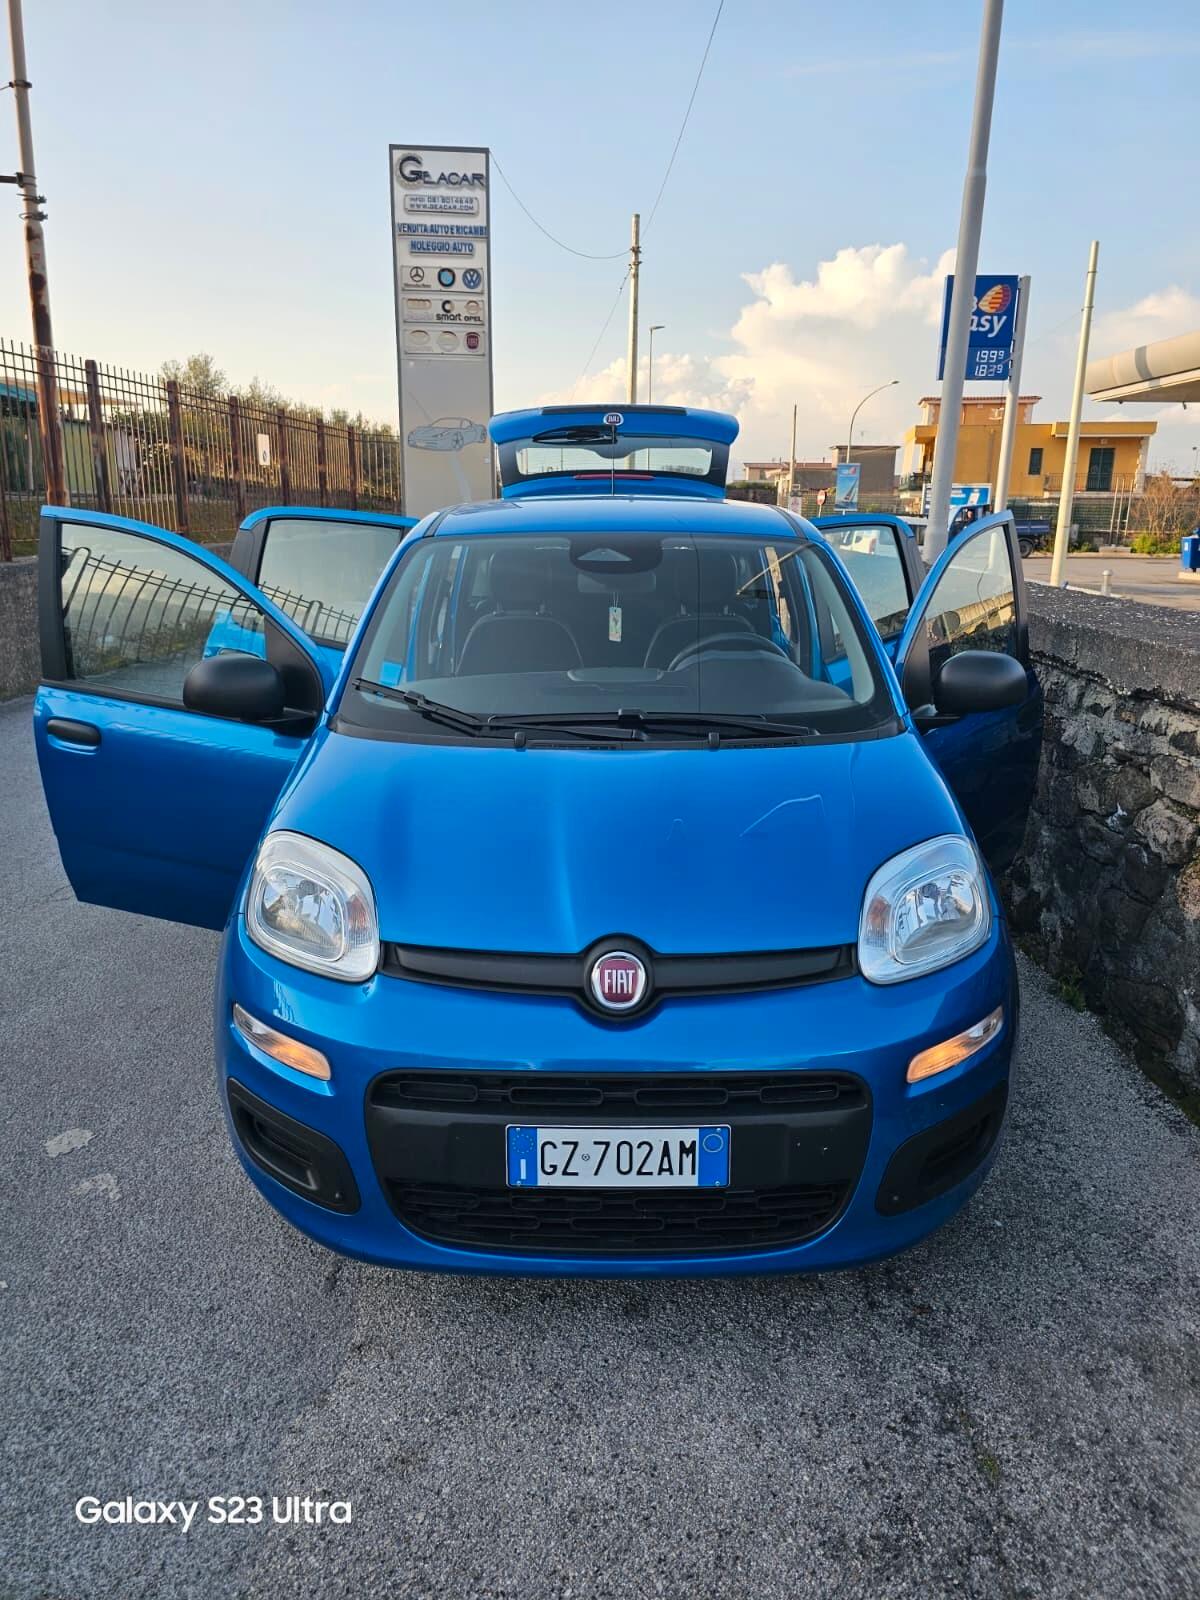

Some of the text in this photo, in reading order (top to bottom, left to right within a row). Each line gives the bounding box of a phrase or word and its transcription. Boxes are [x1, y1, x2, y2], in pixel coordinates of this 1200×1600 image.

[399, 155, 485, 186] GEACAR
[397, 222, 428, 233] VENDITA
[430, 223, 450, 234] AUTO
[410, 239, 474, 253] NOLEGGIO AUTO
[436, 313, 461, 321] smart
[970, 315, 1007, 338] asy
[604, 969, 635, 994] FIAT
[540, 1140, 580, 1177] GZ
